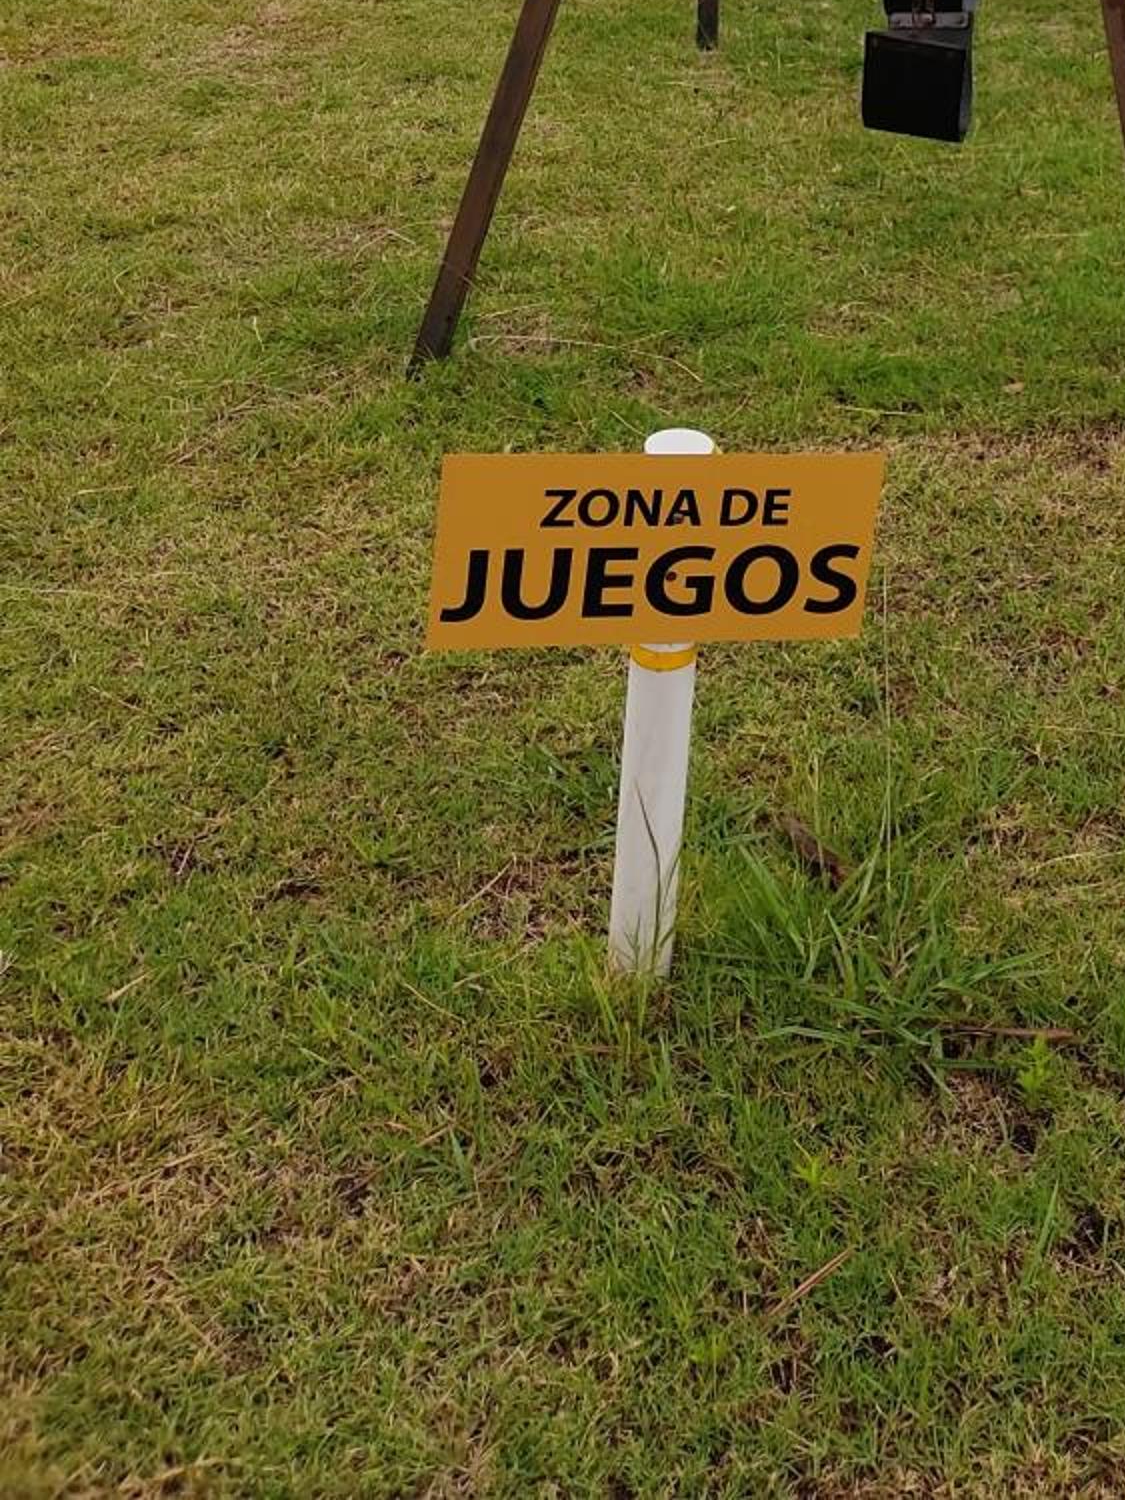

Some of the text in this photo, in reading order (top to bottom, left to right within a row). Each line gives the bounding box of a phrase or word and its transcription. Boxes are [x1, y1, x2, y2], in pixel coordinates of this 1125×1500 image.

[539, 488, 792, 528] ZONA DE
[439, 544, 861, 623] JUEGOS
